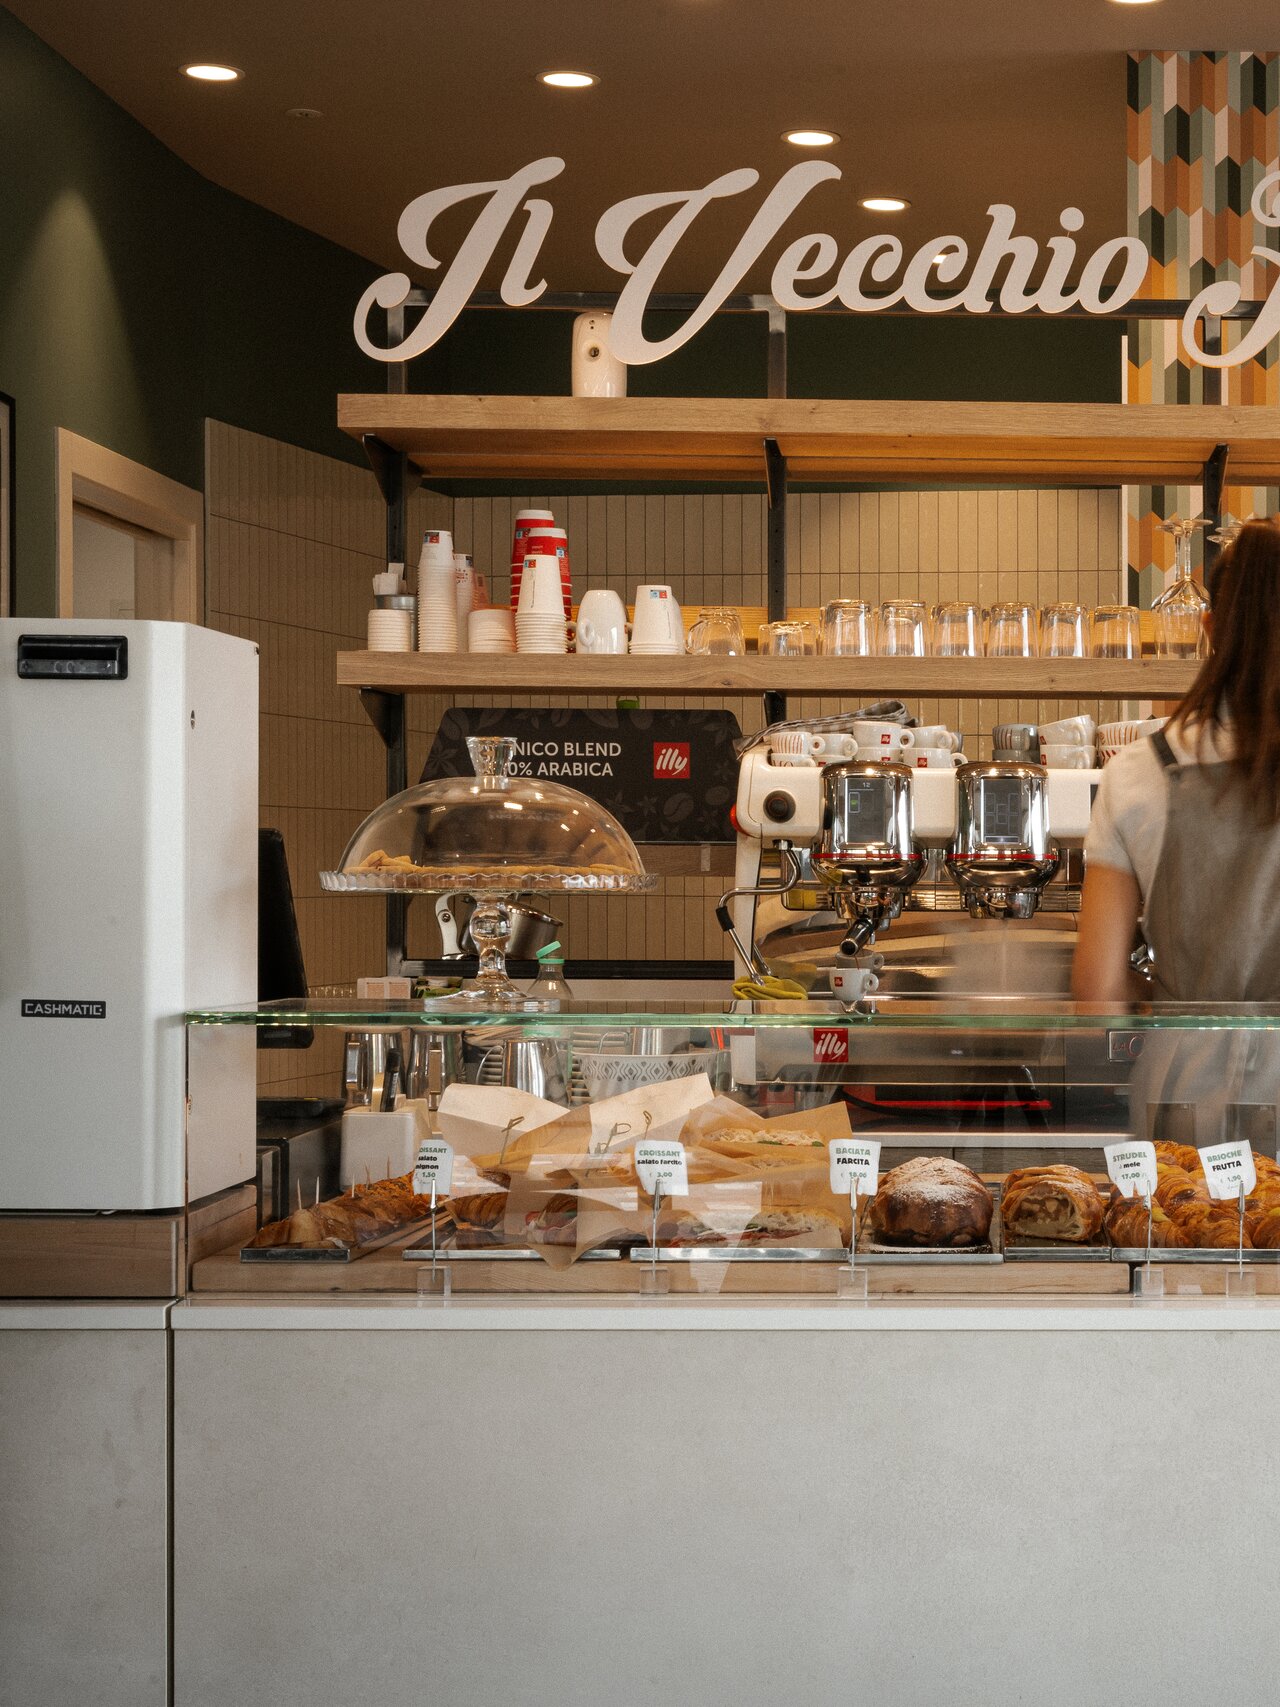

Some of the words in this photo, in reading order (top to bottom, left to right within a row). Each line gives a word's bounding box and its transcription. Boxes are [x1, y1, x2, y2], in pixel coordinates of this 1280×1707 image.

[353, 157, 566, 363] Il
[595, 160, 1149, 365] Vecchio
[514, 742, 559, 756] NICO
[564, 743, 622, 756] BLEND
[656, 748, 688, 776] illy
[537, 762, 614, 776] ARABICA
[25, 1003, 103, 1015] CASHMATIC
[815, 1032, 848, 1060] illy
[639, 1149, 681, 1157] CROISSANT
[835, 1147, 871, 1156] BACIATA
[1112, 1152, 1148, 1162] STRUDEL
[1206, 1150, 1243, 1162] BRIOCHE
[836, 1157, 870, 1165] FARCITA
[1211, 1160, 1242, 1172] FRUTTA
